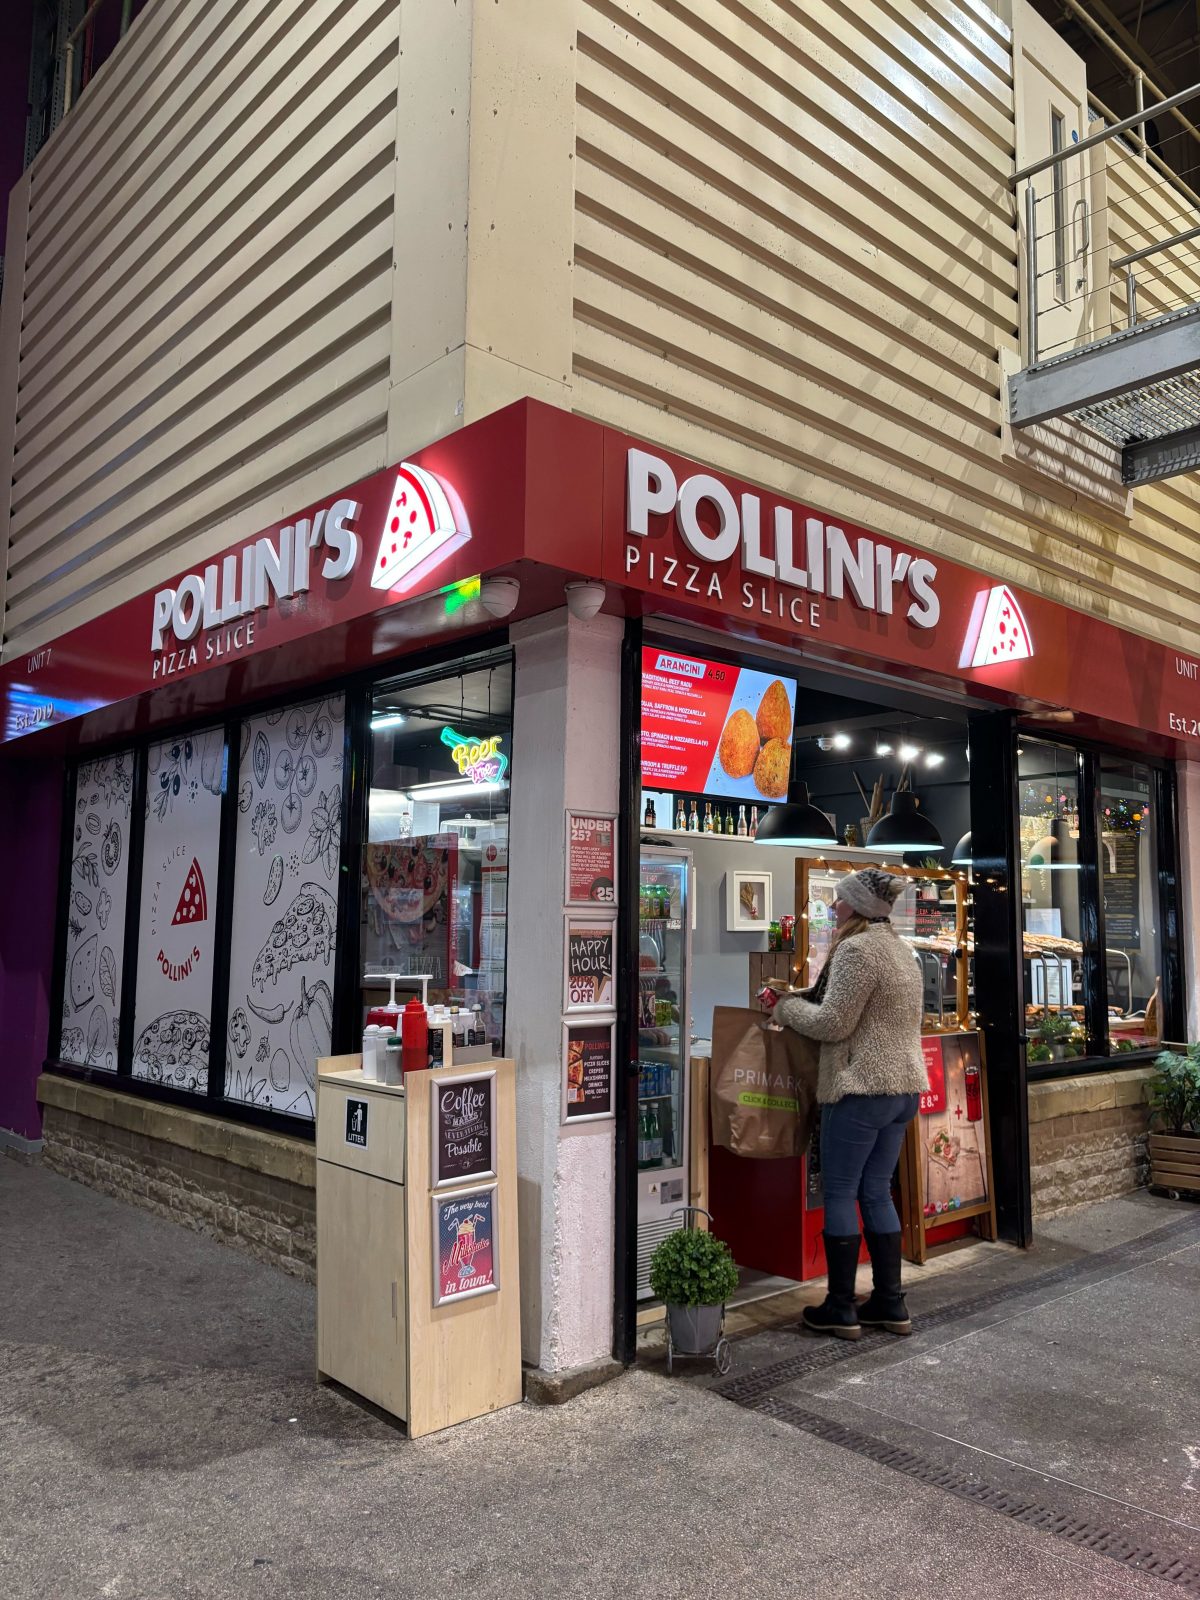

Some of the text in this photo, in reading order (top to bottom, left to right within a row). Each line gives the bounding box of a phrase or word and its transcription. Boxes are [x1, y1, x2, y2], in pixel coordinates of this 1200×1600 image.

[627, 448, 940, 628] POLLINI'S
[151, 499, 361, 652] POLLINI'S
[626, 545, 820, 627] PIZZA SLICE
[27, 648, 52, 674] UNIT 7
[152, 621, 255, 679] PIZZA SLICE
[660, 658, 726, 681] ARANCINI 4.50
[1175, 656, 1199, 681] UNIT
[15, 702, 55, 731] Est.2019
[1169, 712, 1200, 736] Est.2
[452, 736, 502, 775] Beer
[571, 817, 612, 832] UNDER
[571, 830, 592, 842] 25?
[162, 845, 187, 872] SLICE
[597, 886, 614, 901] 25
[570, 938, 609, 958] HAPPY
[157, 945, 200, 982] POLLINI'S
[572, 954, 611, 974] HOUR!
[570, 976, 594, 989] 20%
[570, 989, 594, 1004] OFF
[734, 1068, 802, 1091] PRIMARK
[440, 1087, 486, 1118] Coffee
[348, 1132, 364, 1144] LITTER
[445, 1138, 482, 1158] Possible
[444, 1200, 488, 1220] The very best
[445, 1270, 492, 1294] in town!
